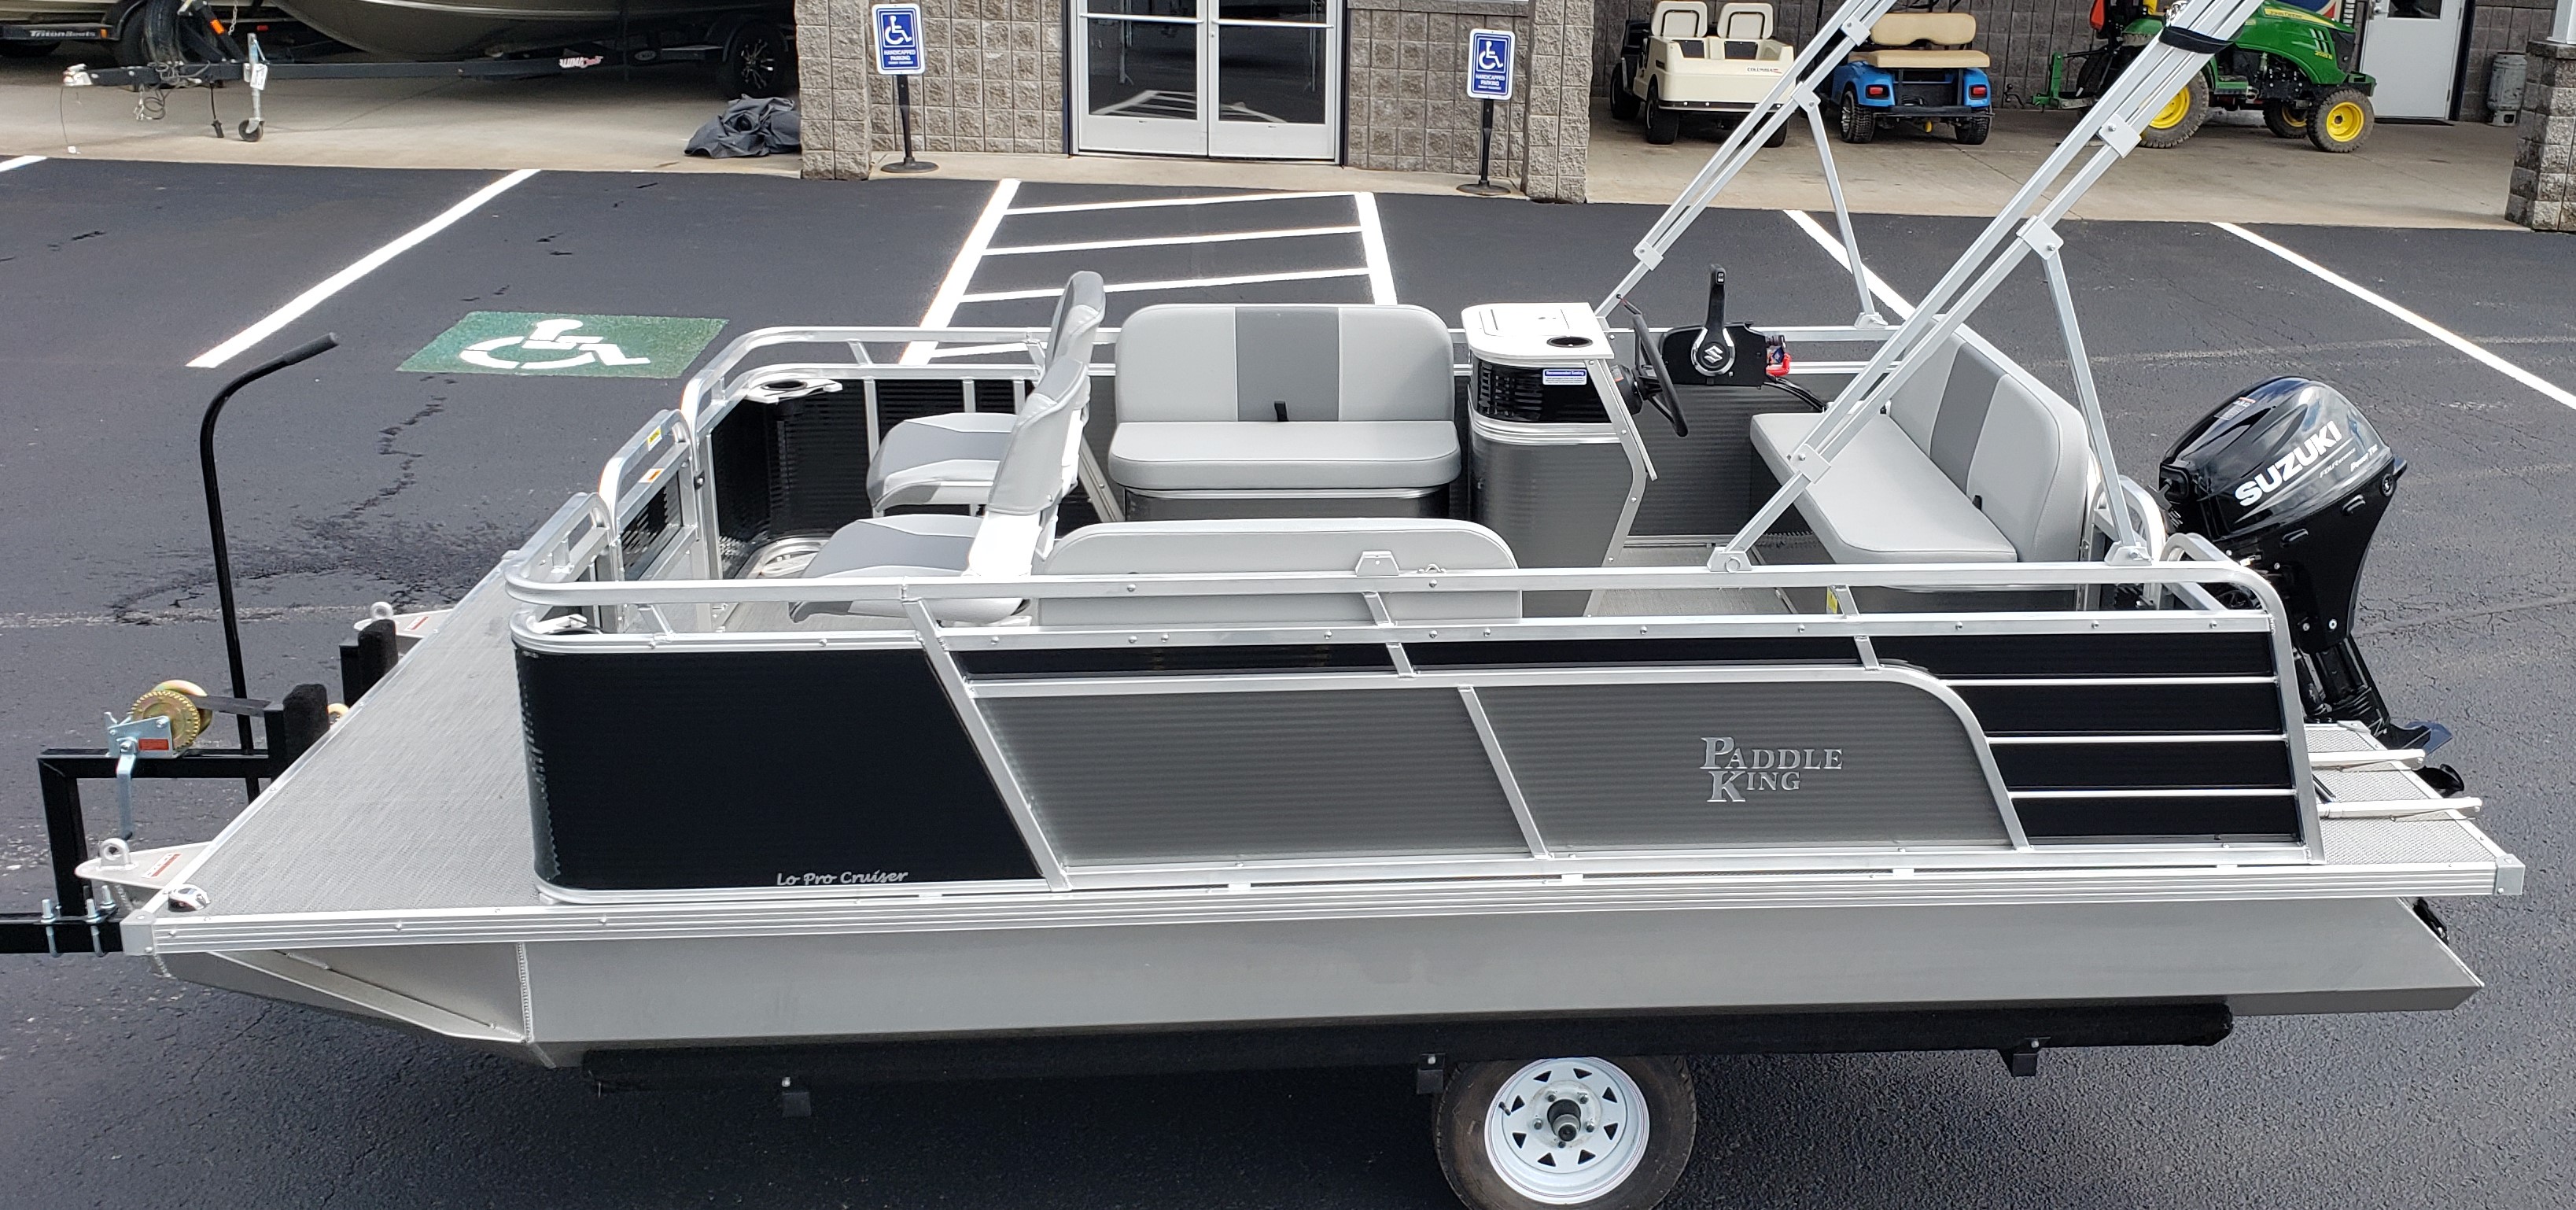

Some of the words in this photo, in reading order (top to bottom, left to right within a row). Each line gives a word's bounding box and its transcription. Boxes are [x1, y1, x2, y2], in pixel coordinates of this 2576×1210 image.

[2235, 420, 2342, 507] SUZUKI
[1699, 736, 1843, 770] PADDLE
[1707, 770, 1800, 802] KING
[776, 872, 801, 886] Lo
[803, 872, 838, 886] Pro
[840, 869, 908, 884] Cruiser
